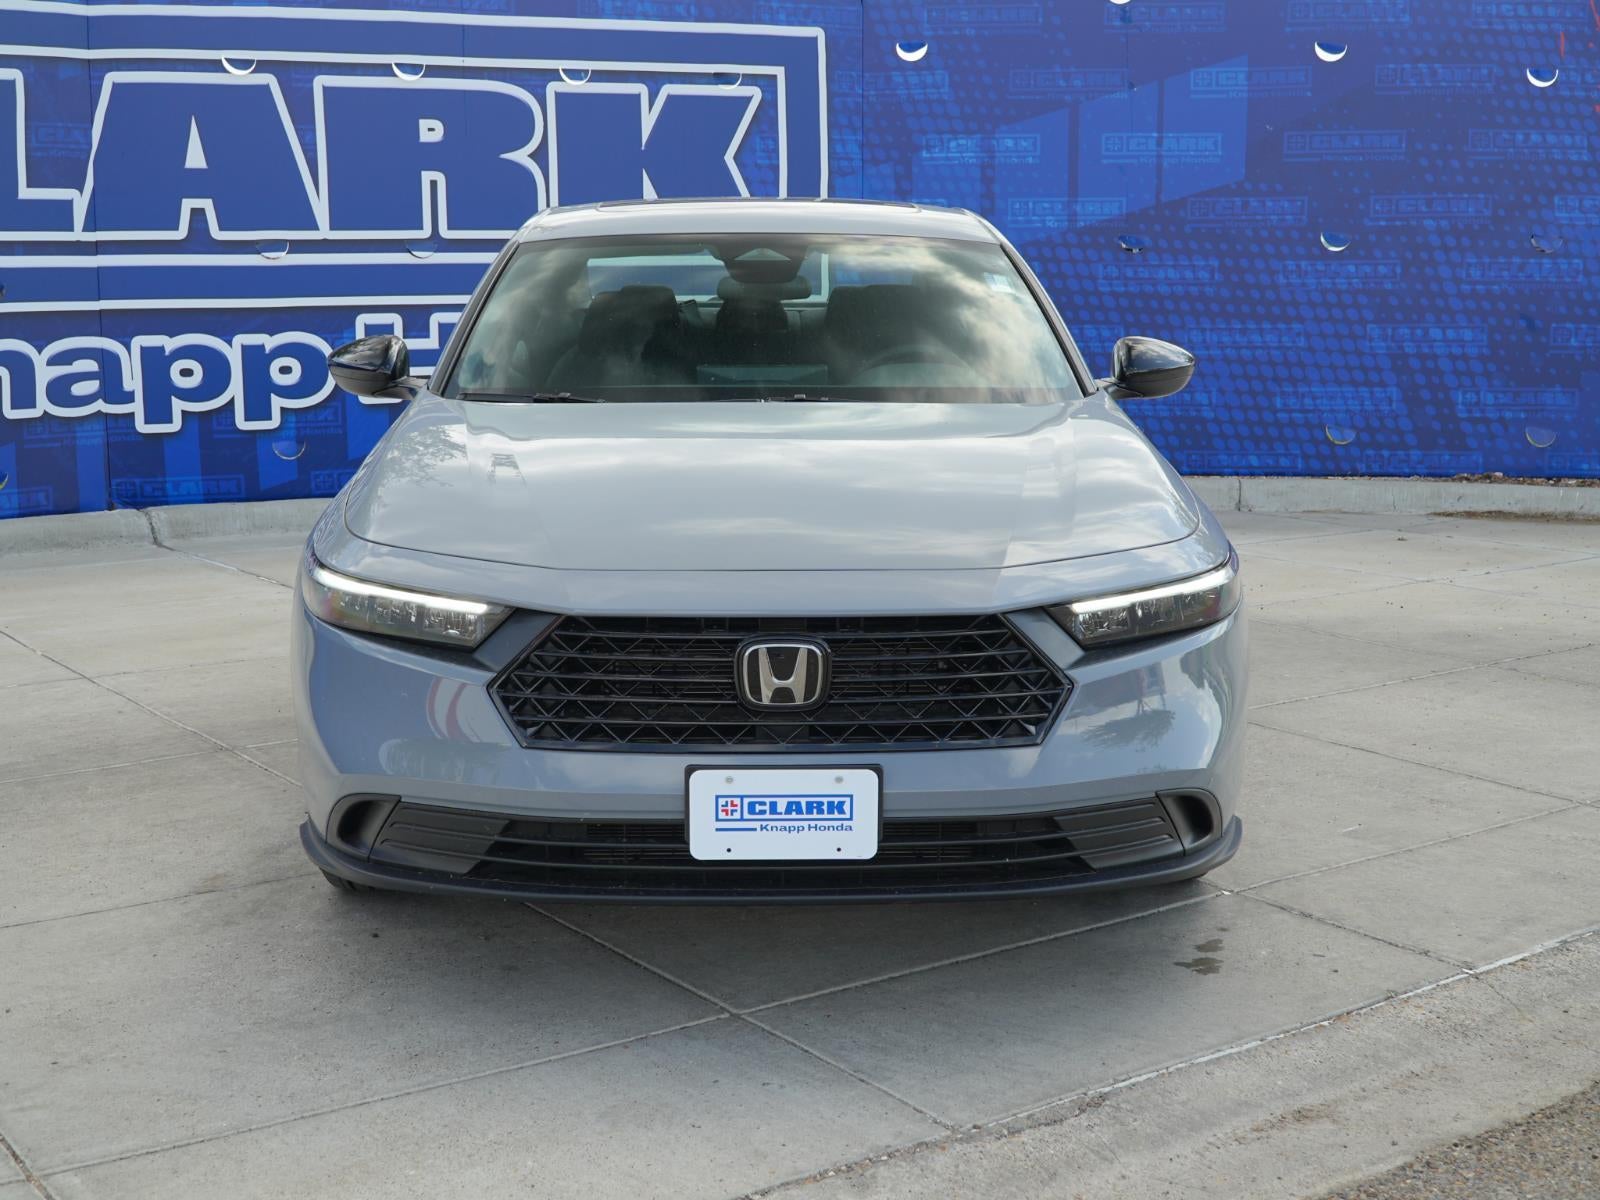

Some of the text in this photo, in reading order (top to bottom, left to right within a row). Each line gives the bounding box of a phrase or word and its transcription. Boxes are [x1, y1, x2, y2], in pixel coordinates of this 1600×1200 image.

[747, 800, 847, 816] CLARK
[759, 823, 854, 834] Knapp Honda
